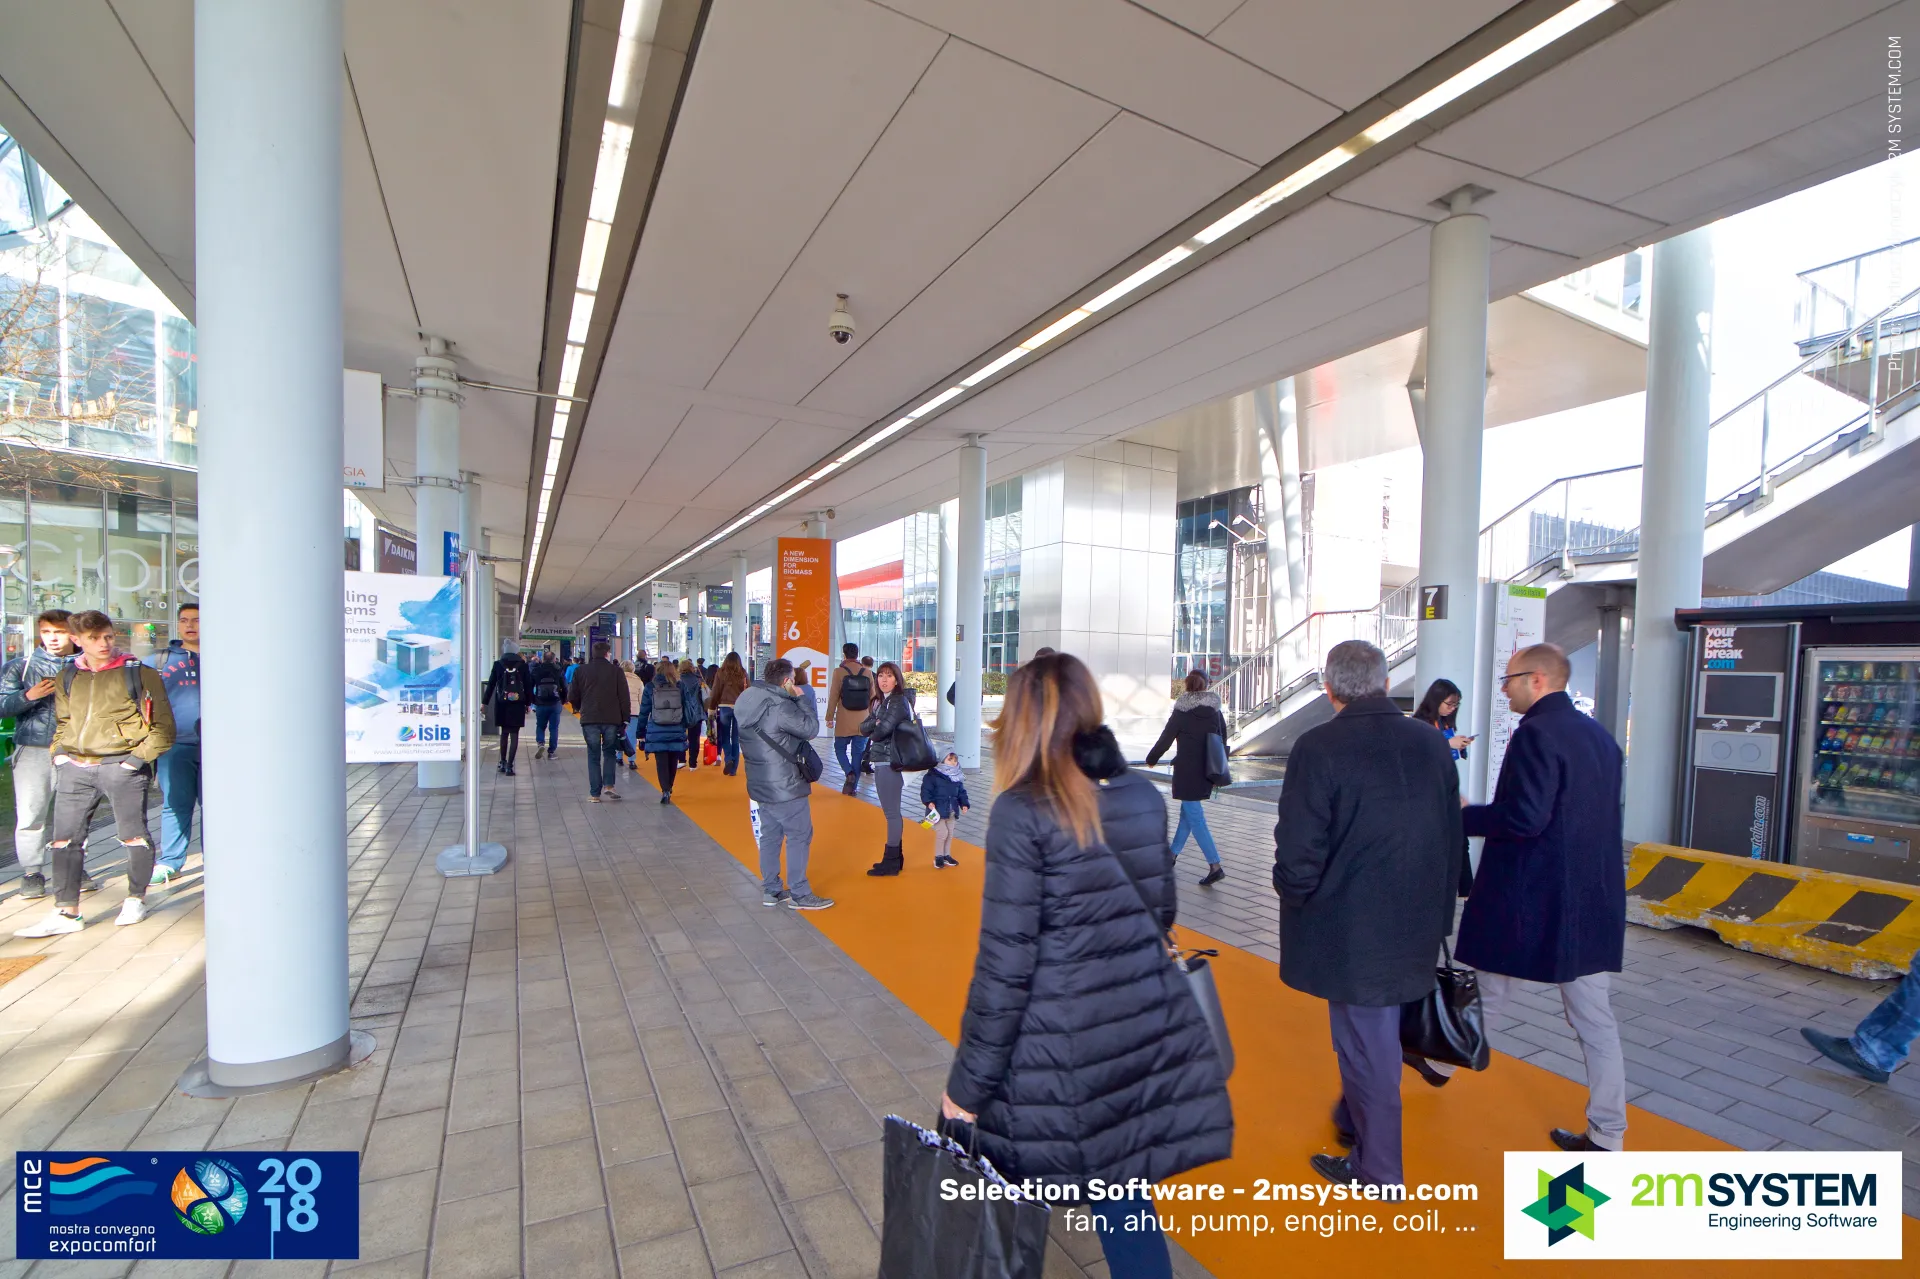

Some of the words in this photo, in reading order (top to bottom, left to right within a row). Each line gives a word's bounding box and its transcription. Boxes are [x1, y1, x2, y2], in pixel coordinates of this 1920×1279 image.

[391, 544, 416, 562] DAIKIN
[1425, 587, 1439, 606] 7
[1425, 606, 1435, 619] E
[788, 621, 800, 640] 6
[1705, 627, 1737, 639] your
[1705, 637, 1734, 648] best
[1704, 648, 1744, 659] break
[1703, 659, 1735, 669] .com
